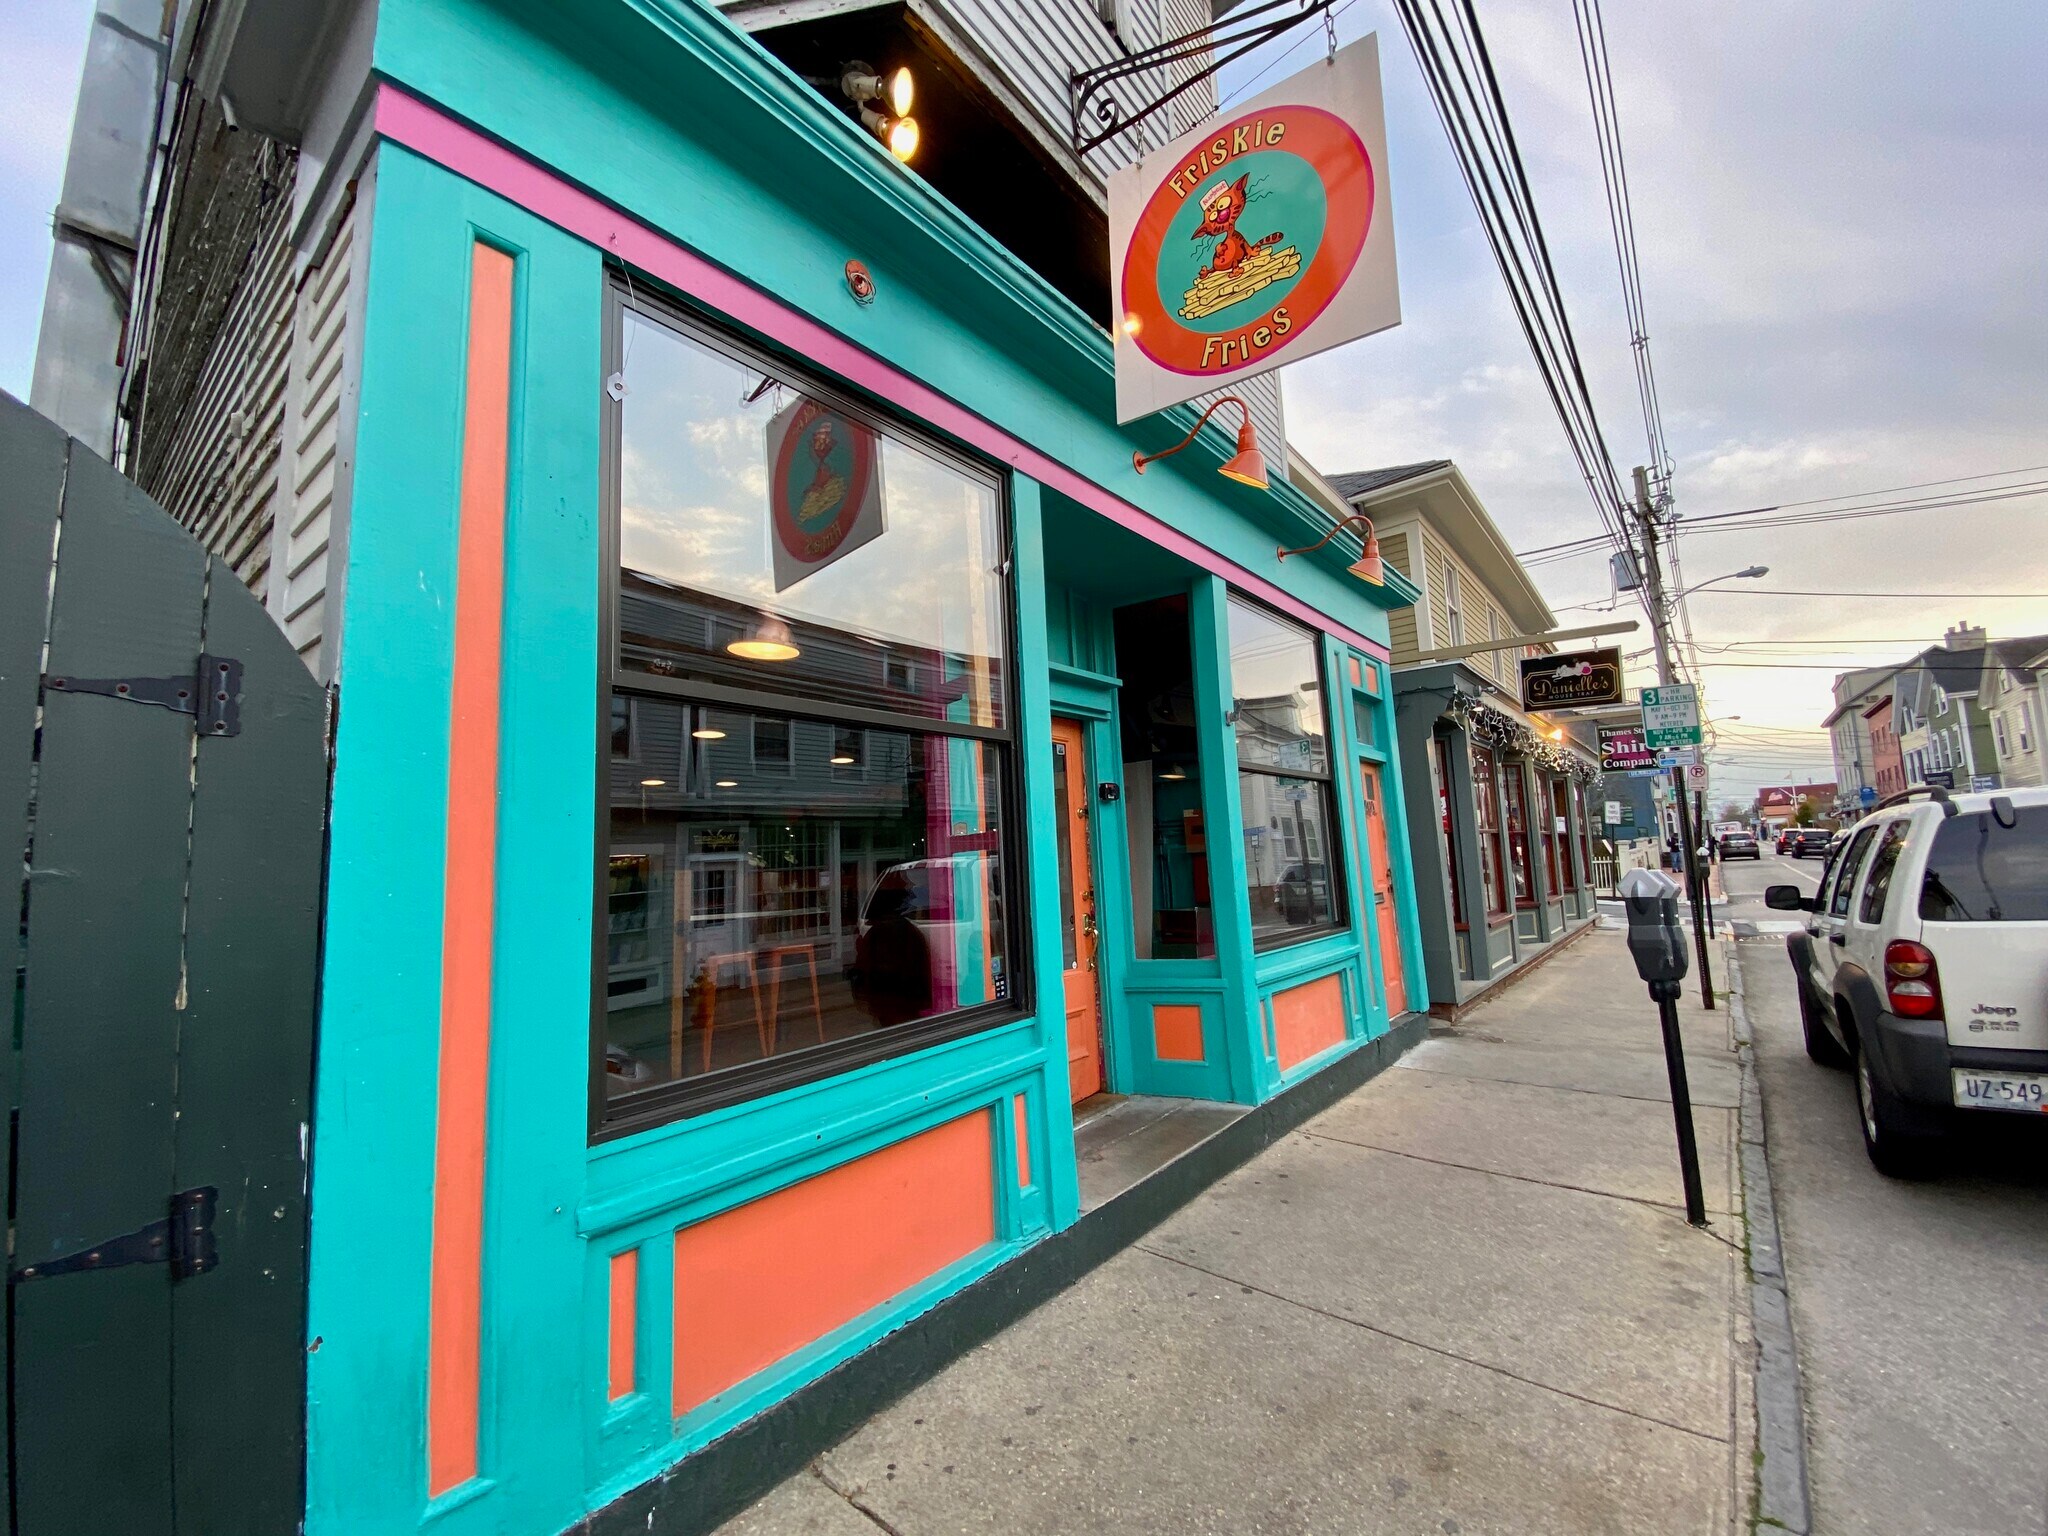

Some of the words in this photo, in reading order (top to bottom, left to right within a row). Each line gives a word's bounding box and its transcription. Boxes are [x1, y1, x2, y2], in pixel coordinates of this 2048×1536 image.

[1200, 307, 1293, 368] Fries
[1533, 675, 1609, 696] Danielle's
[1644, 690, 1656, 704] 3
[1660, 694, 1693, 702] PARKING
[1600, 728, 1631, 737] Thames
[1601, 740, 1646, 755] Shir
[1602, 757, 1657, 768] Company
[1970, 1003, 2017, 1017] Jeep
[1966, 1080, 2042, 1103] UZ-549
